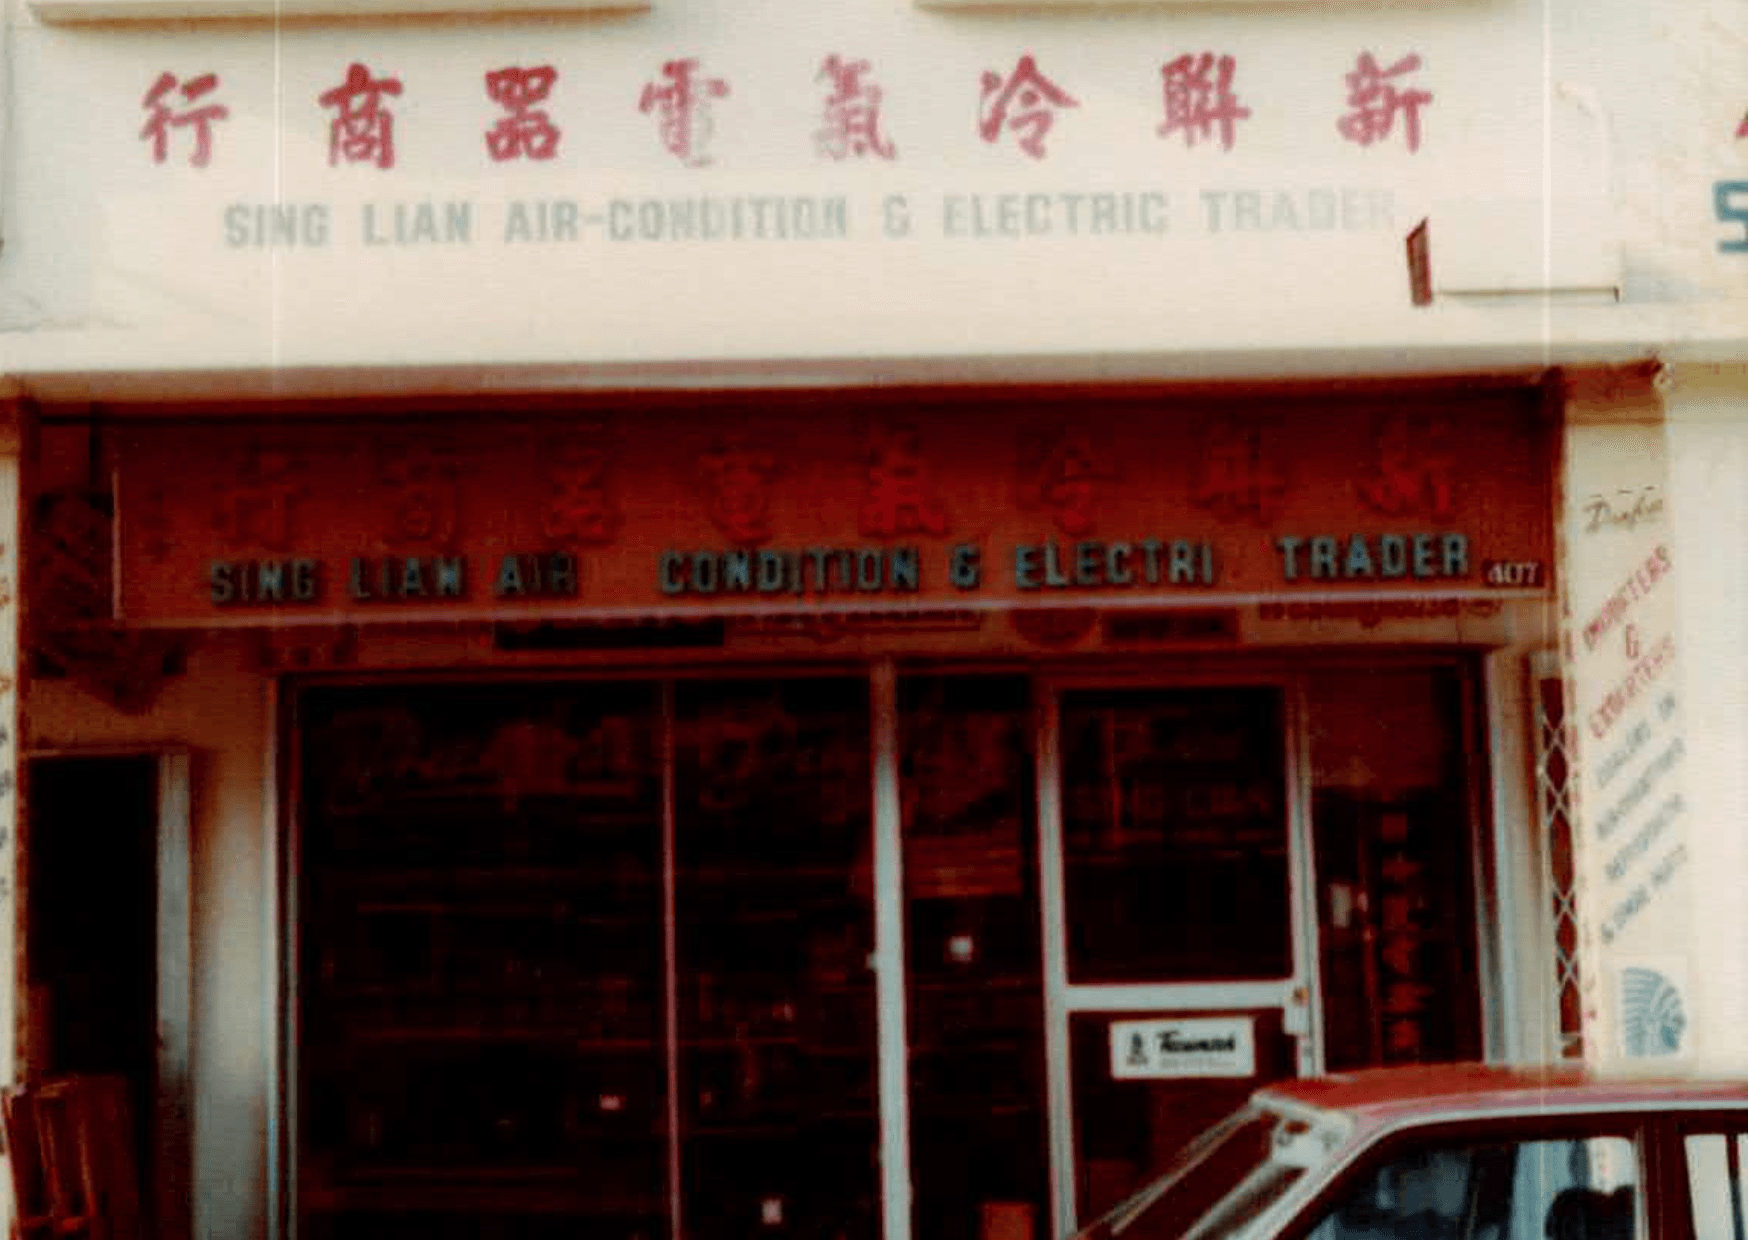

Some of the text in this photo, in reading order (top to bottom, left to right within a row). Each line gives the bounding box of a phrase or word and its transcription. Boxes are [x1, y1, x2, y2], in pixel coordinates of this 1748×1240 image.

[223, 202, 330, 250] SING
[362, 201, 472, 247] LIAN
[504, 196, 848, 245] AIR-CONDITION
[944, 192, 1169, 238] ELECTRIC
[1202, 187, 1398, 235] TRADER
[209, 557, 316, 603] SING
[348, 556, 465, 599] LIAN
[497, 552, 580, 597] AIR
[657, 544, 921, 596] CONDITION
[1014, 537, 1215, 590] ELECTRI
[1276, 532, 1471, 583] TRADER
[1486, 560, 1542, 586] 407
